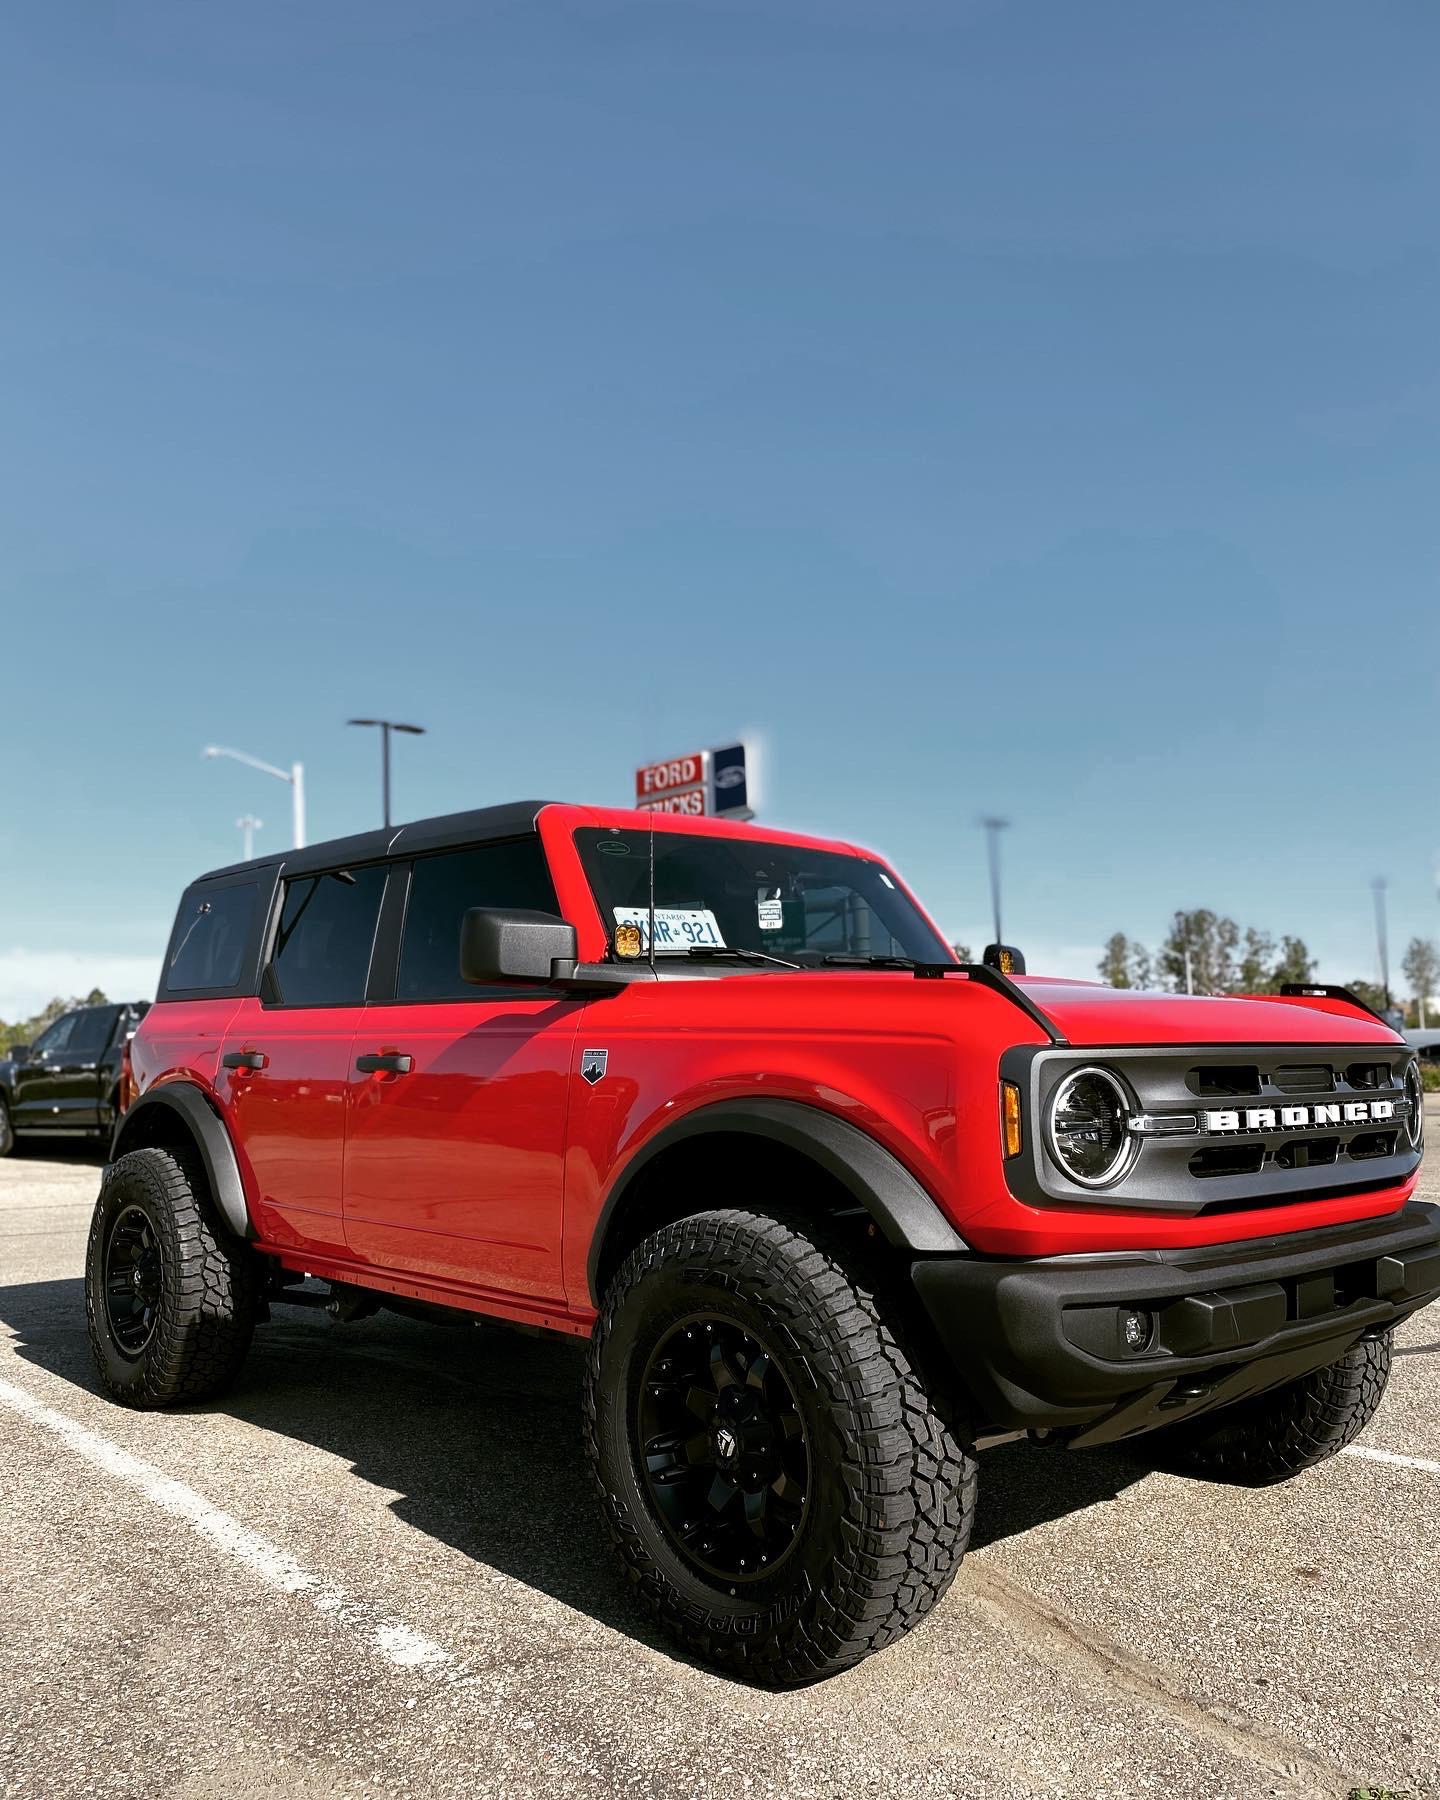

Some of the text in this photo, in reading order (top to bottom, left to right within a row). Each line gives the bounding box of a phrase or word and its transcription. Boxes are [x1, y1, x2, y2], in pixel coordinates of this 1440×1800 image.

[643, 759, 697, 792] FORD
[639, 792, 703, 815] UCKS
[681, 921, 719, 944] 921
[1207, 1100, 1394, 1131] BRONCO
